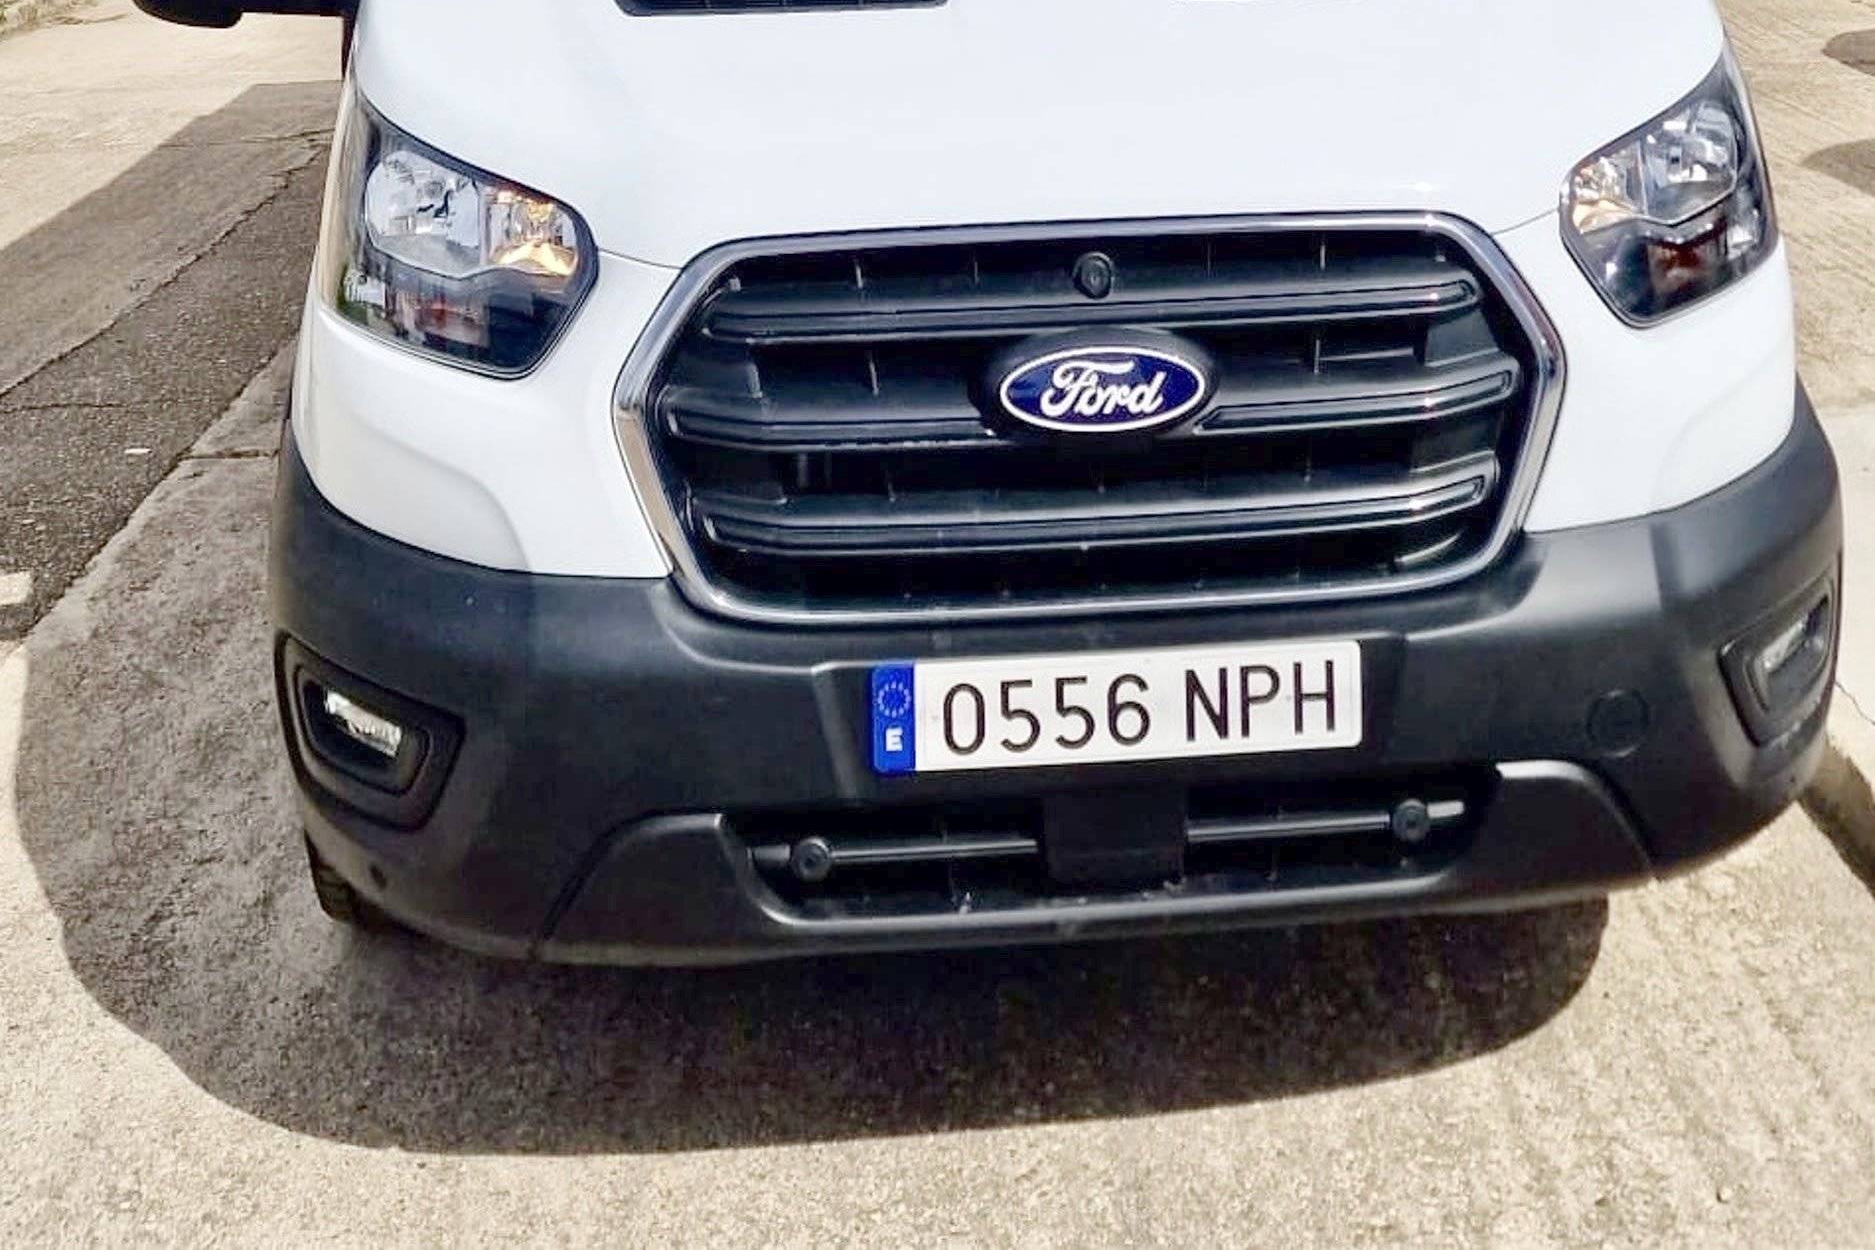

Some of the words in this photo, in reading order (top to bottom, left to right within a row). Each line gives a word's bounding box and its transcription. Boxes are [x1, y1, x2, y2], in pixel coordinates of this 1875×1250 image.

[1040, 360, 1167, 417] Ford
[884, 727, 903, 752] E
[943, 673, 1151, 756] 0556
[1184, 660, 1336, 742] NPH
